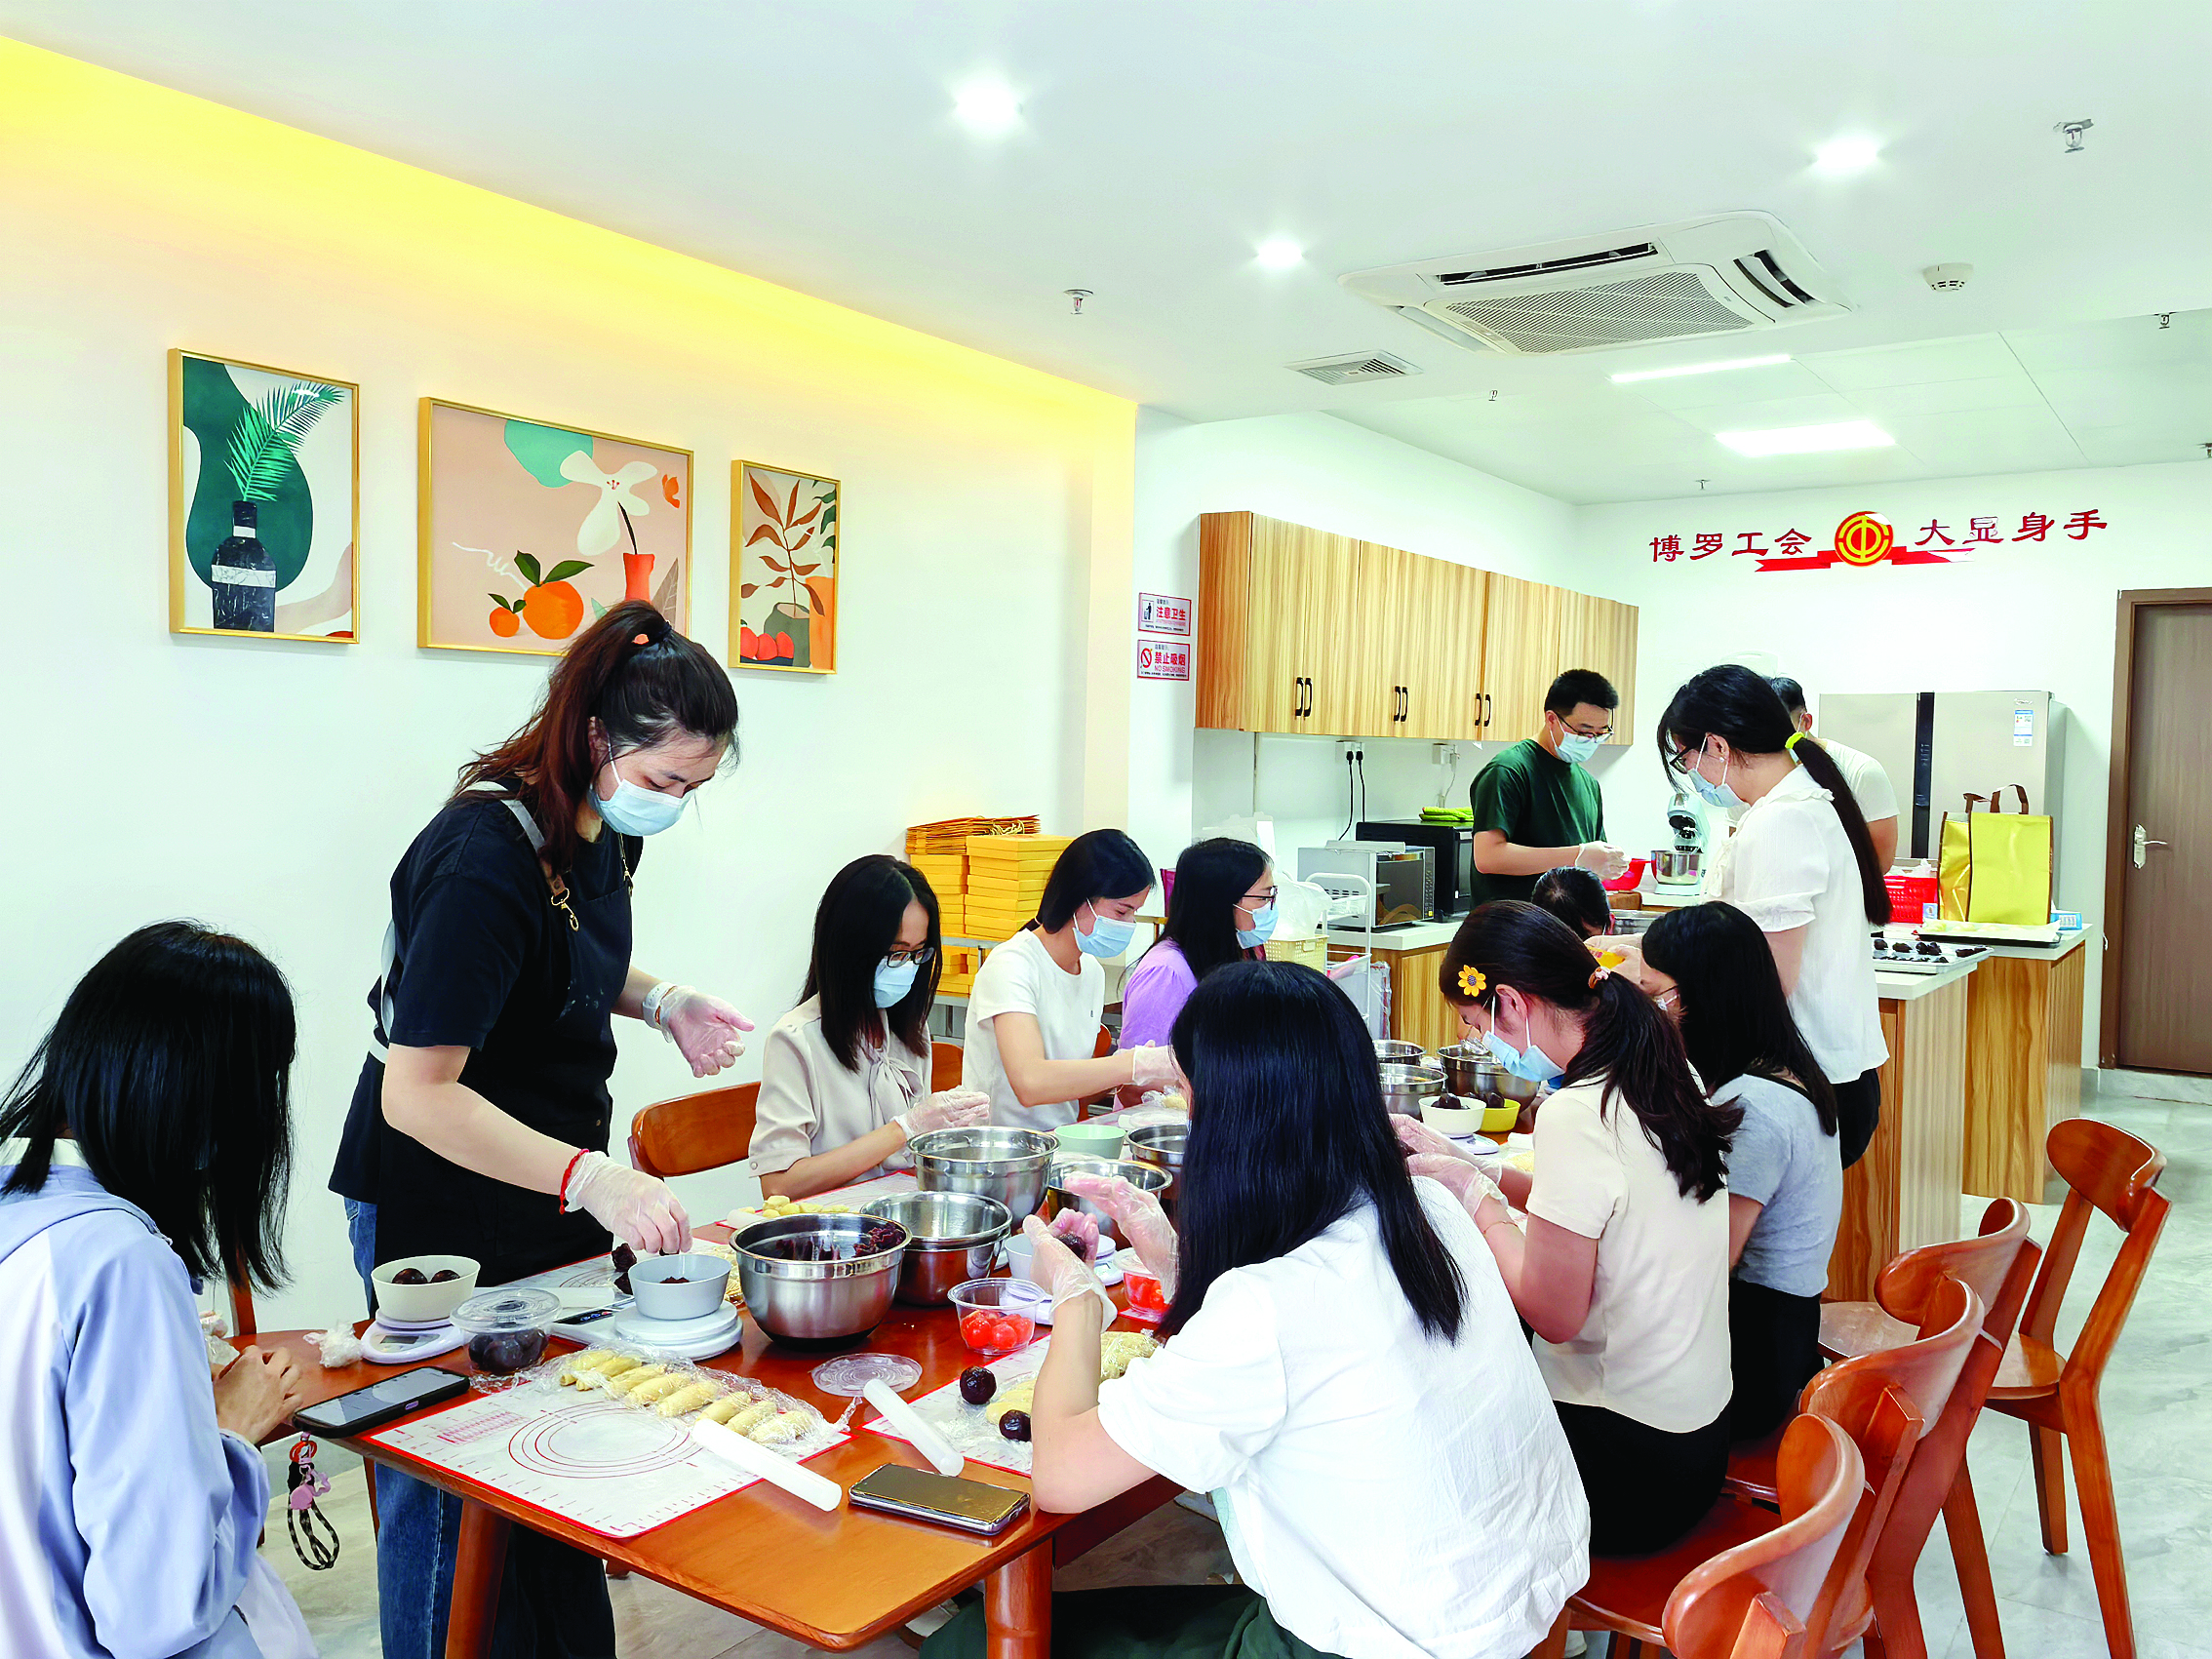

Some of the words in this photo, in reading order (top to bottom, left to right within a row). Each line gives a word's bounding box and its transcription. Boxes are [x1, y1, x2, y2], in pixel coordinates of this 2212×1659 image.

[1648, 527, 1812, 563] 博罗工会
[1915, 509, 2109, 547] 大显身手
[1157, 607, 1185, 620] 注意卫生
[1155, 652, 1186, 666] 禁止吸烟
